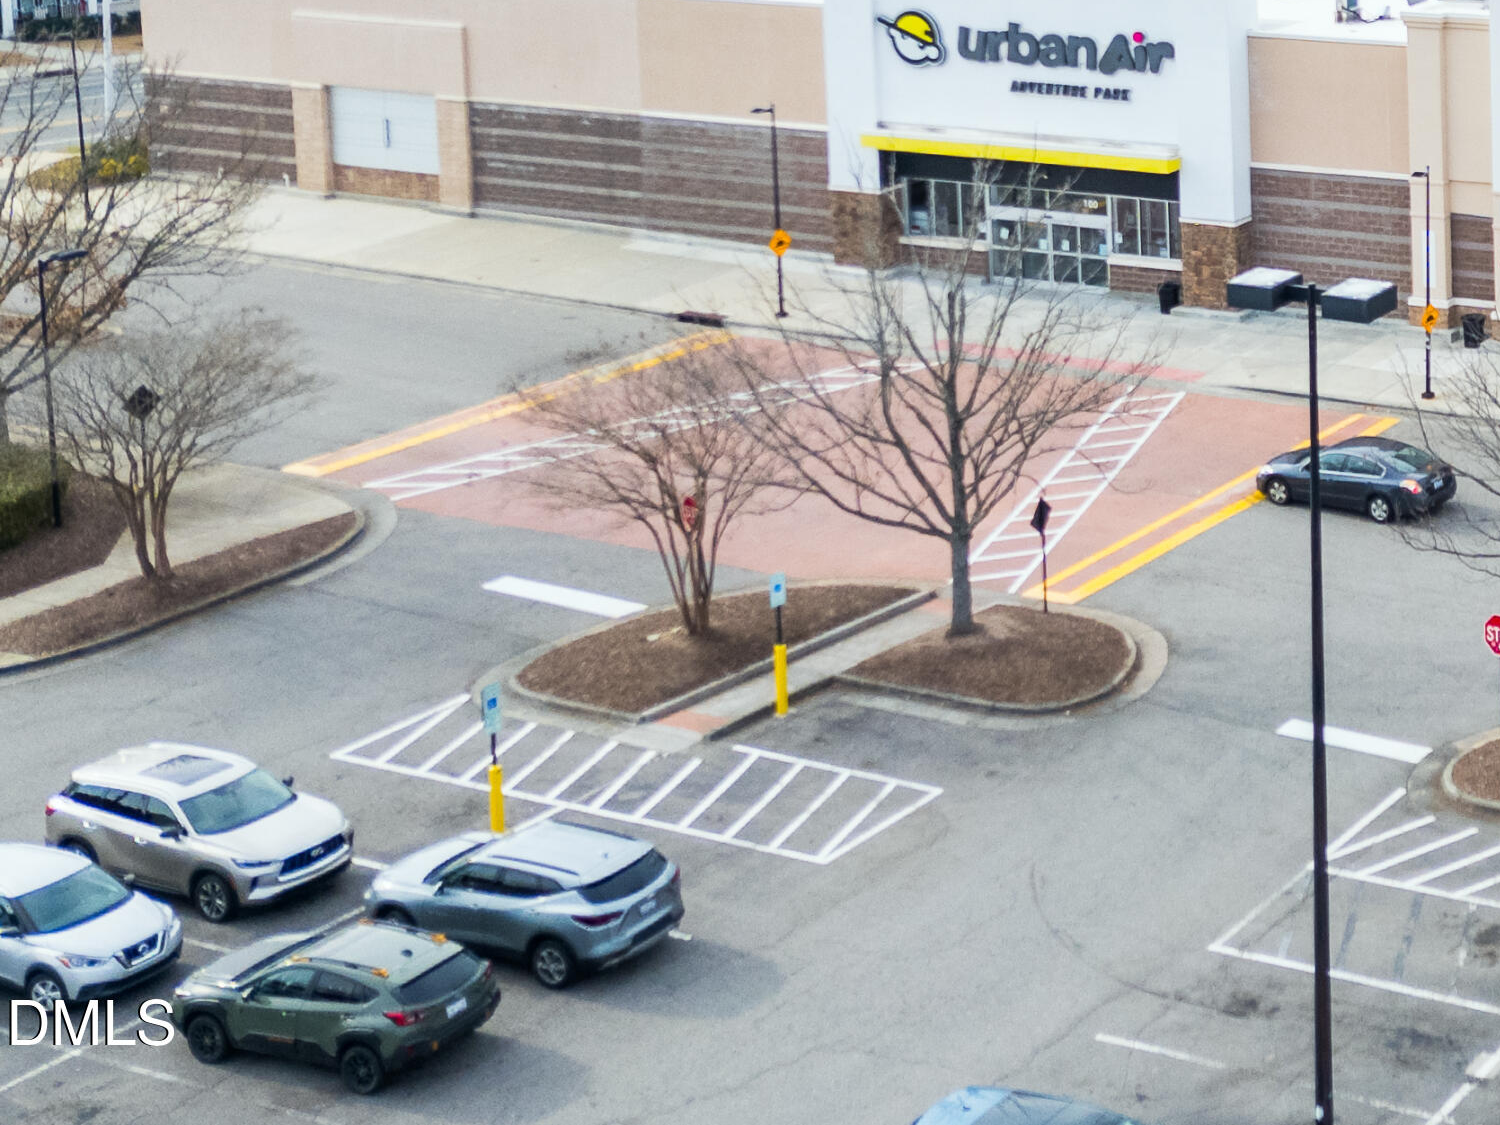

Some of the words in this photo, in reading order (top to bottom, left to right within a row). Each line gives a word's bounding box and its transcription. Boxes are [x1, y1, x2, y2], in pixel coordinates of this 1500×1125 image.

[1010, 80, 1088, 99] ADVENTURE
[1094, 87, 1132, 102] PARK
[1083, 199, 1099, 210] 100
